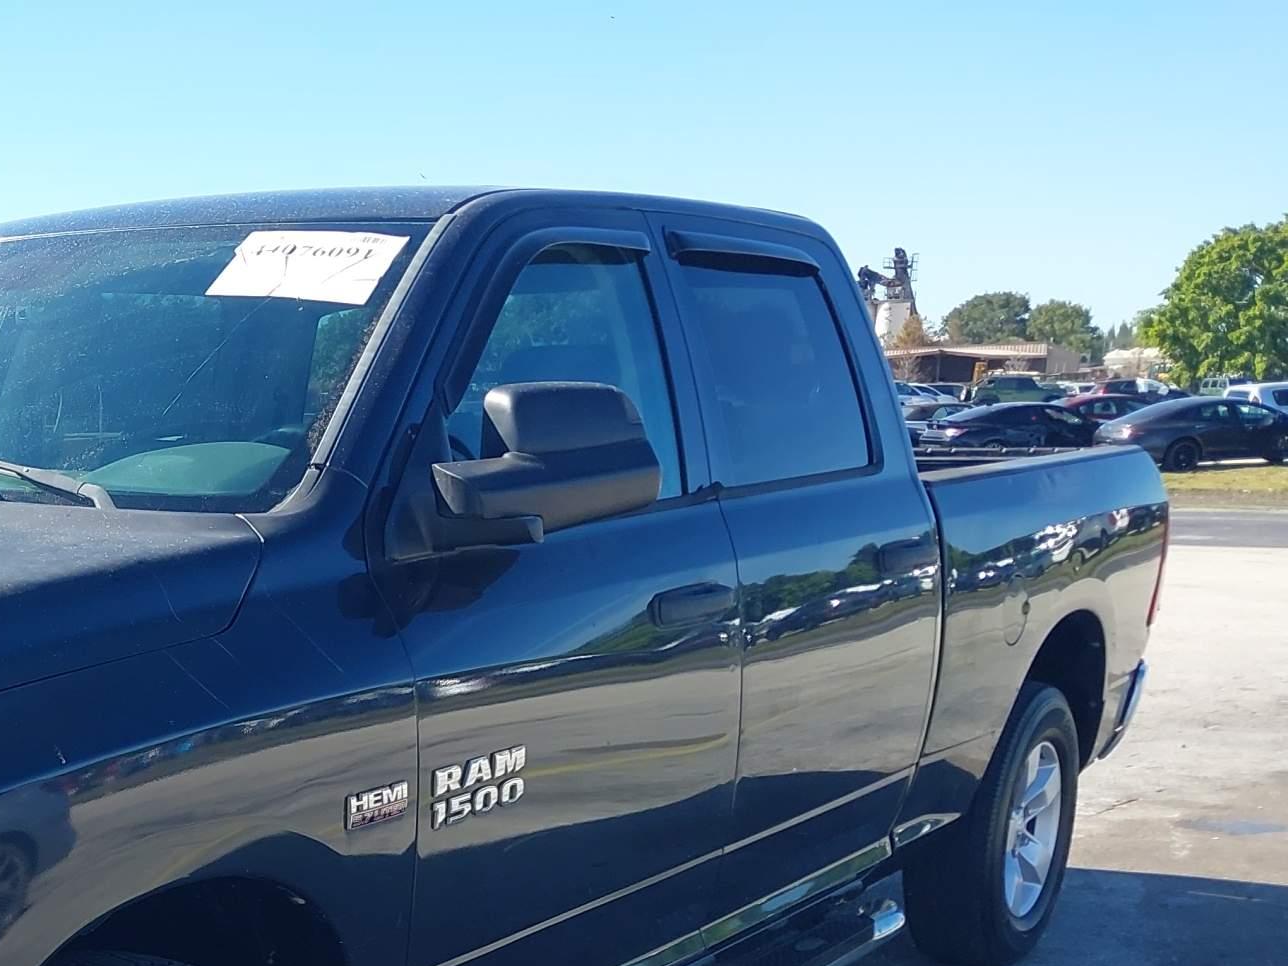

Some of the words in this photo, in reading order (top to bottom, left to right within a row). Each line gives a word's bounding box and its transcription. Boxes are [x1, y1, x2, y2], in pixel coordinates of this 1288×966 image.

[432, 745, 526, 797] RAM
[350, 781, 408, 814] HEMI
[432, 777, 524, 830] 1500
